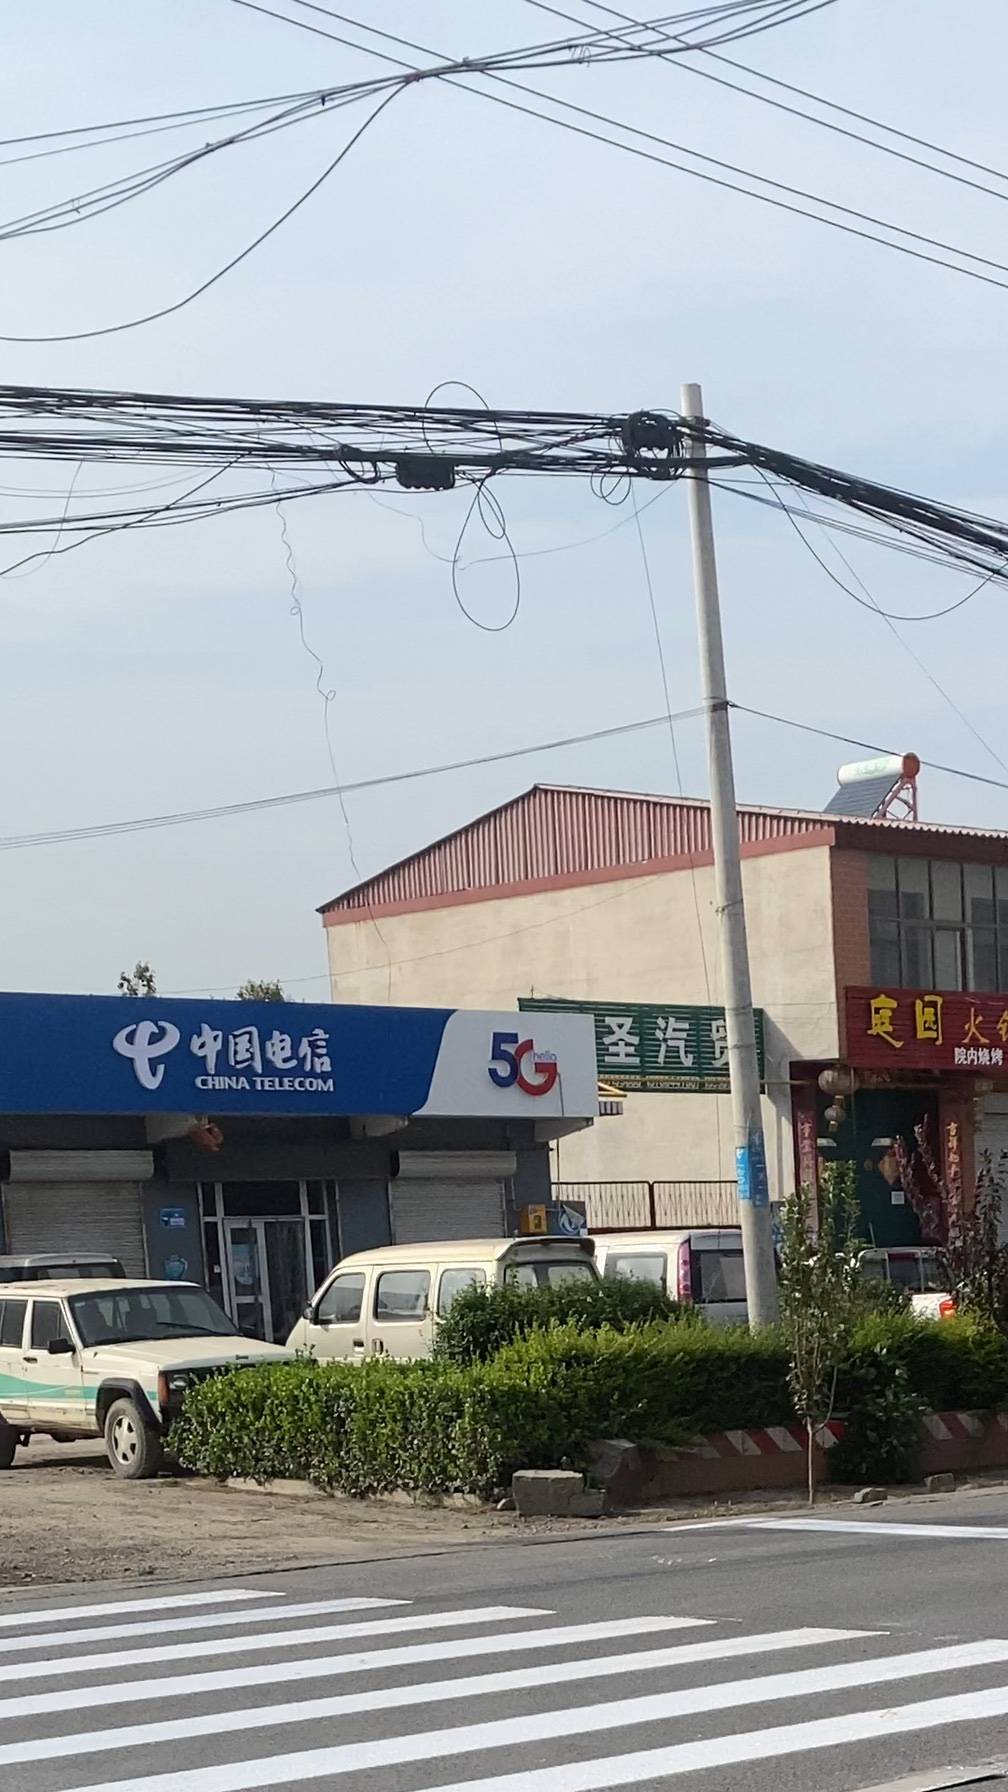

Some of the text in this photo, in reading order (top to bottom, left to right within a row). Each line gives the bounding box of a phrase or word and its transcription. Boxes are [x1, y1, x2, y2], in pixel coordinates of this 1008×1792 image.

[190, 1022, 332, 1074] 中国电信
[488, 1031, 557, 1096] 5G
[954, 1047, 1003, 1066] 院内烧烤
[195, 1075, 334, 1092] CHINA TELECOM
